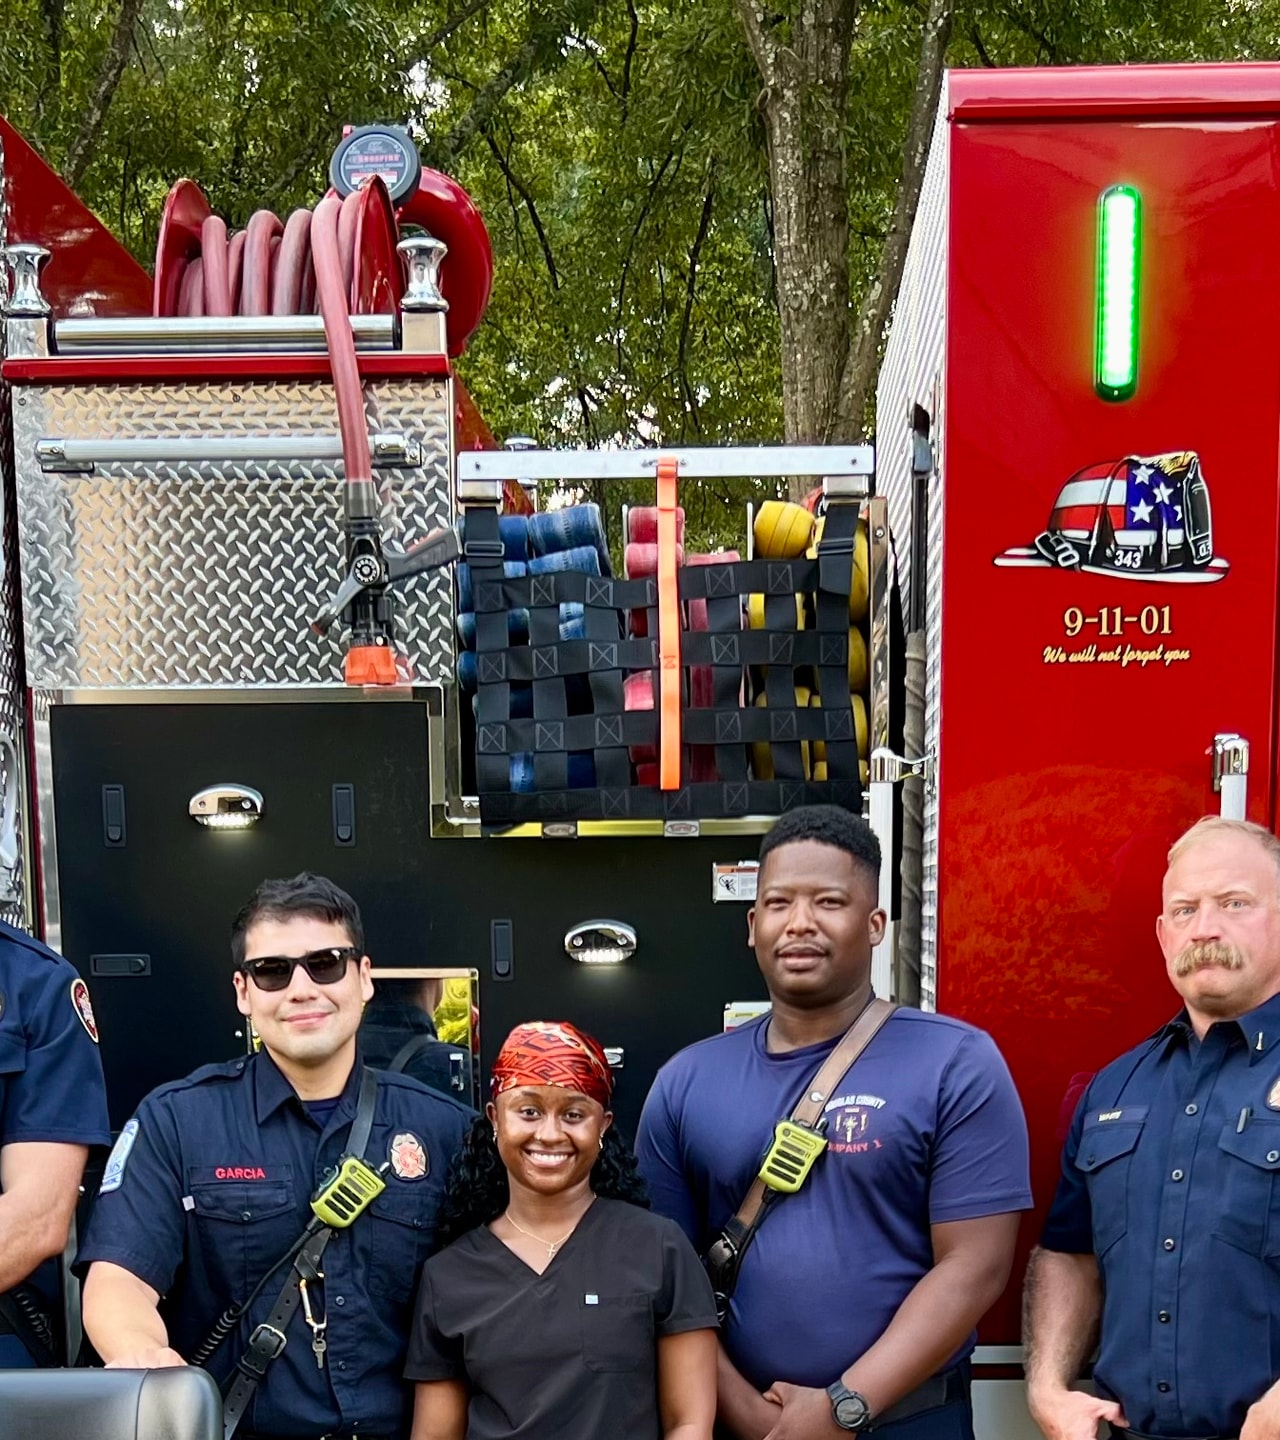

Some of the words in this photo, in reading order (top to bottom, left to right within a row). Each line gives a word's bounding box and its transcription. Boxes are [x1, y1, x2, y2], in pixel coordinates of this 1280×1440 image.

[1114, 551, 1141, 568] 343
[1064, 605, 1172, 636] 9-11-01
[1043, 646, 1066, 663] We
[1069, 644, 1096, 662] will
[1098, 645, 1121, 661] not
[1122, 644, 1164, 667] forget
[1164, 649, 1190, 666] you
[215, 1167, 265, 1180] GARCIA
